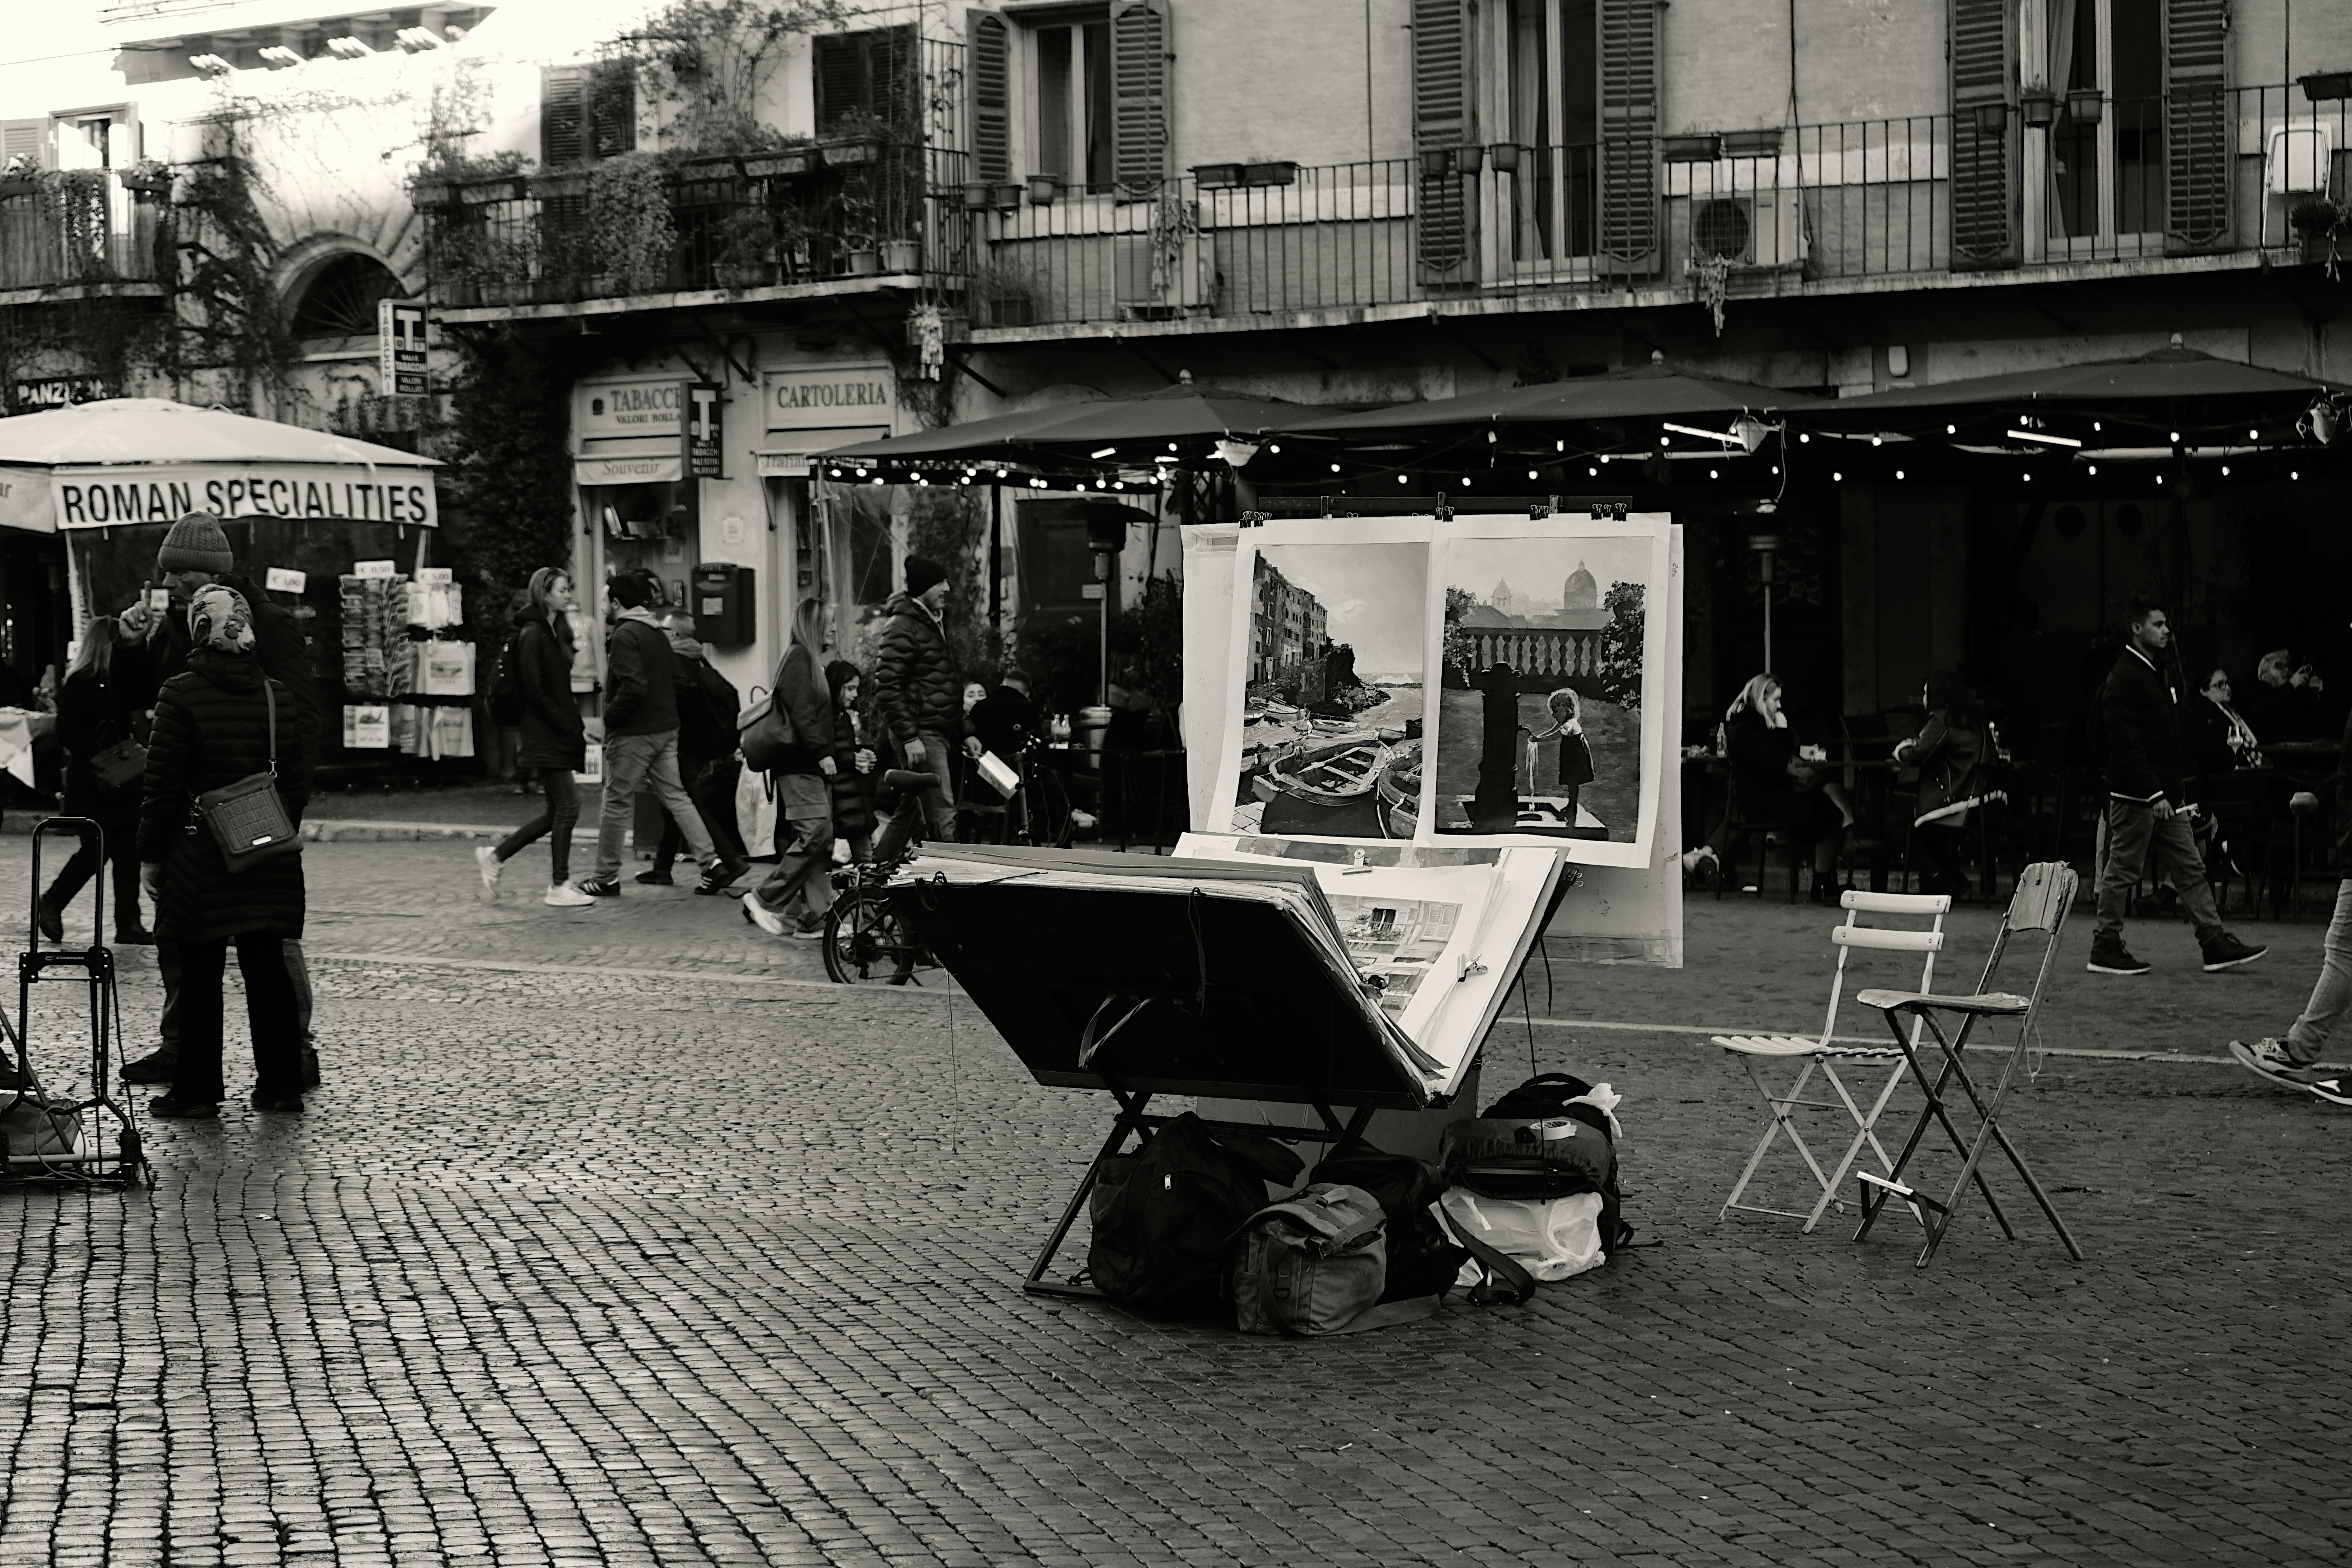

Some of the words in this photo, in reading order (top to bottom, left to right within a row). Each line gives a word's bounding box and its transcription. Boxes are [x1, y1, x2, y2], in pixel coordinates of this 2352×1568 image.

[396, 309, 422, 351] T
[383, 305, 391, 392] TABACCHI
[396, 360, 427, 372] TABACCHI
[401, 376, 422, 385] VALORI
[778, 383, 887, 408] CARTOLERIA
[616, 414, 648, 425] VALORI
[692, 389, 716, 441] T
[692, 447, 719, 456] TABACCHI
[603, 460, 661, 475] Souvenir
[62, 482, 191, 523] ROMAN
[206, 479, 427, 523] SPECIALITIES
